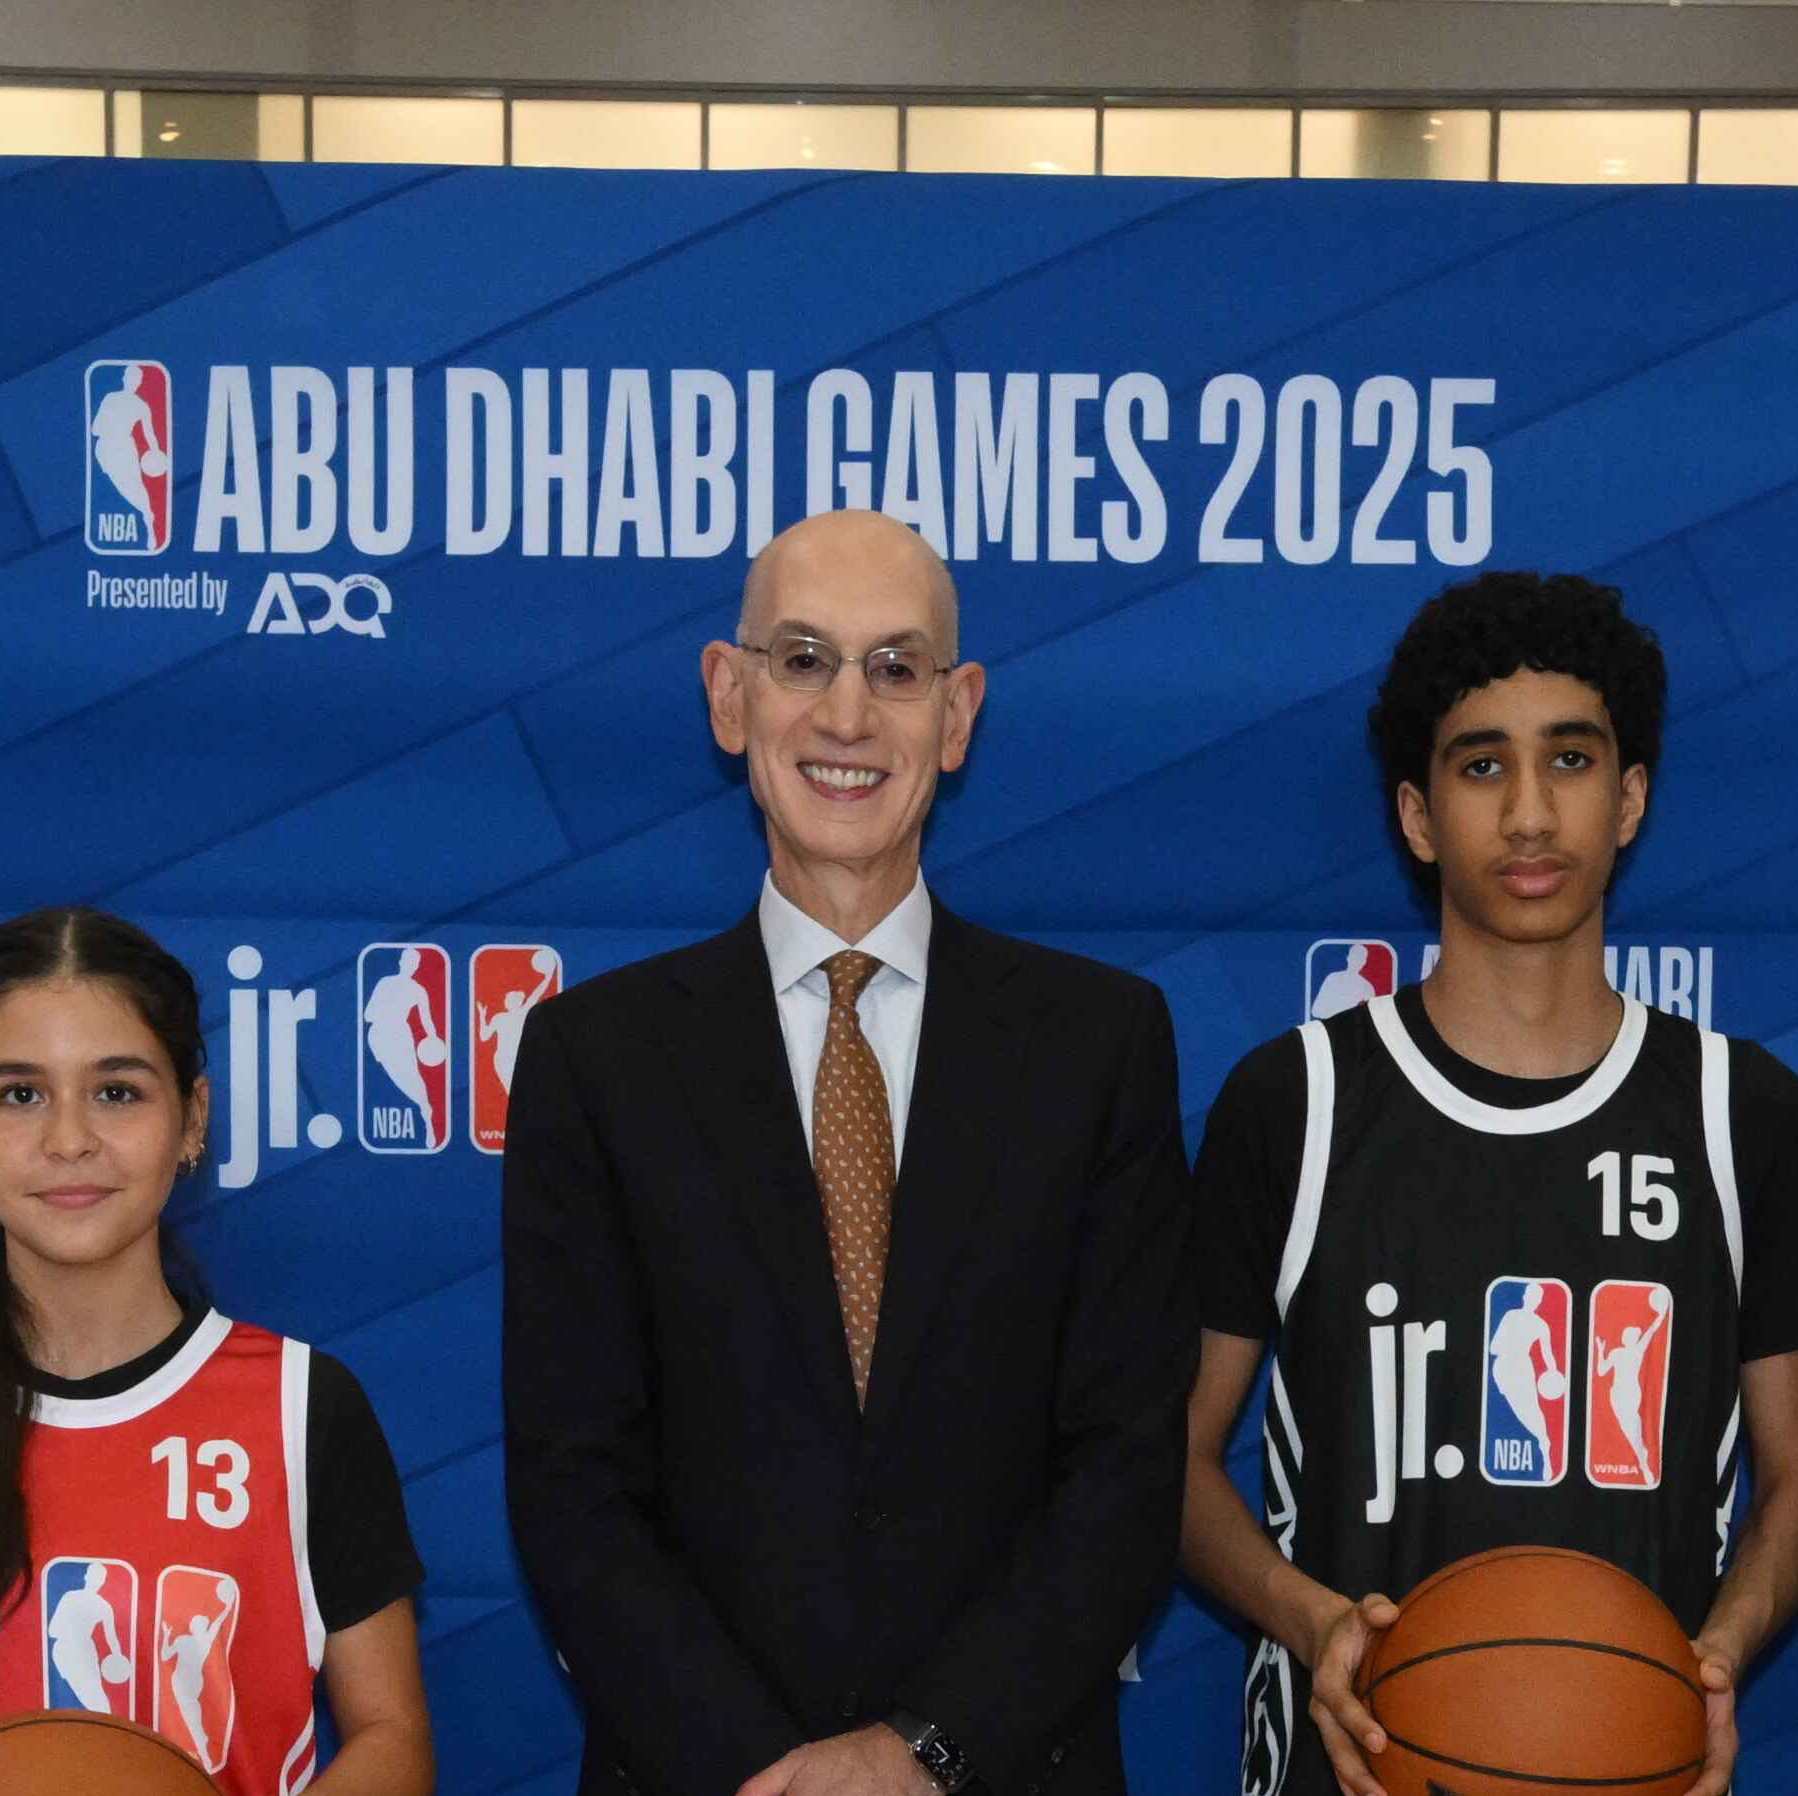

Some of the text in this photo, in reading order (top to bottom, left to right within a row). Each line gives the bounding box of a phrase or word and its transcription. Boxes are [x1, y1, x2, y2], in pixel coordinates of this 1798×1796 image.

[193, 365, 1496, 567] ABU DHABI GAMES 2025
[98, 513, 138, 542] NBA
[87, 569, 228, 616] Presented by
[246, 572, 393, 639] ADQ
[218, 944, 343, 1189] jr.
[372, 1107, 415, 1139] NBA
[1587, 1150, 1680, 1241] 15
[1365, 1282, 1465, 1524] jr.
[151, 1436, 251, 1530] 13
[1493, 1438, 1534, 1472] NBA
[1593, 1464, 1639, 1476] WNBA
